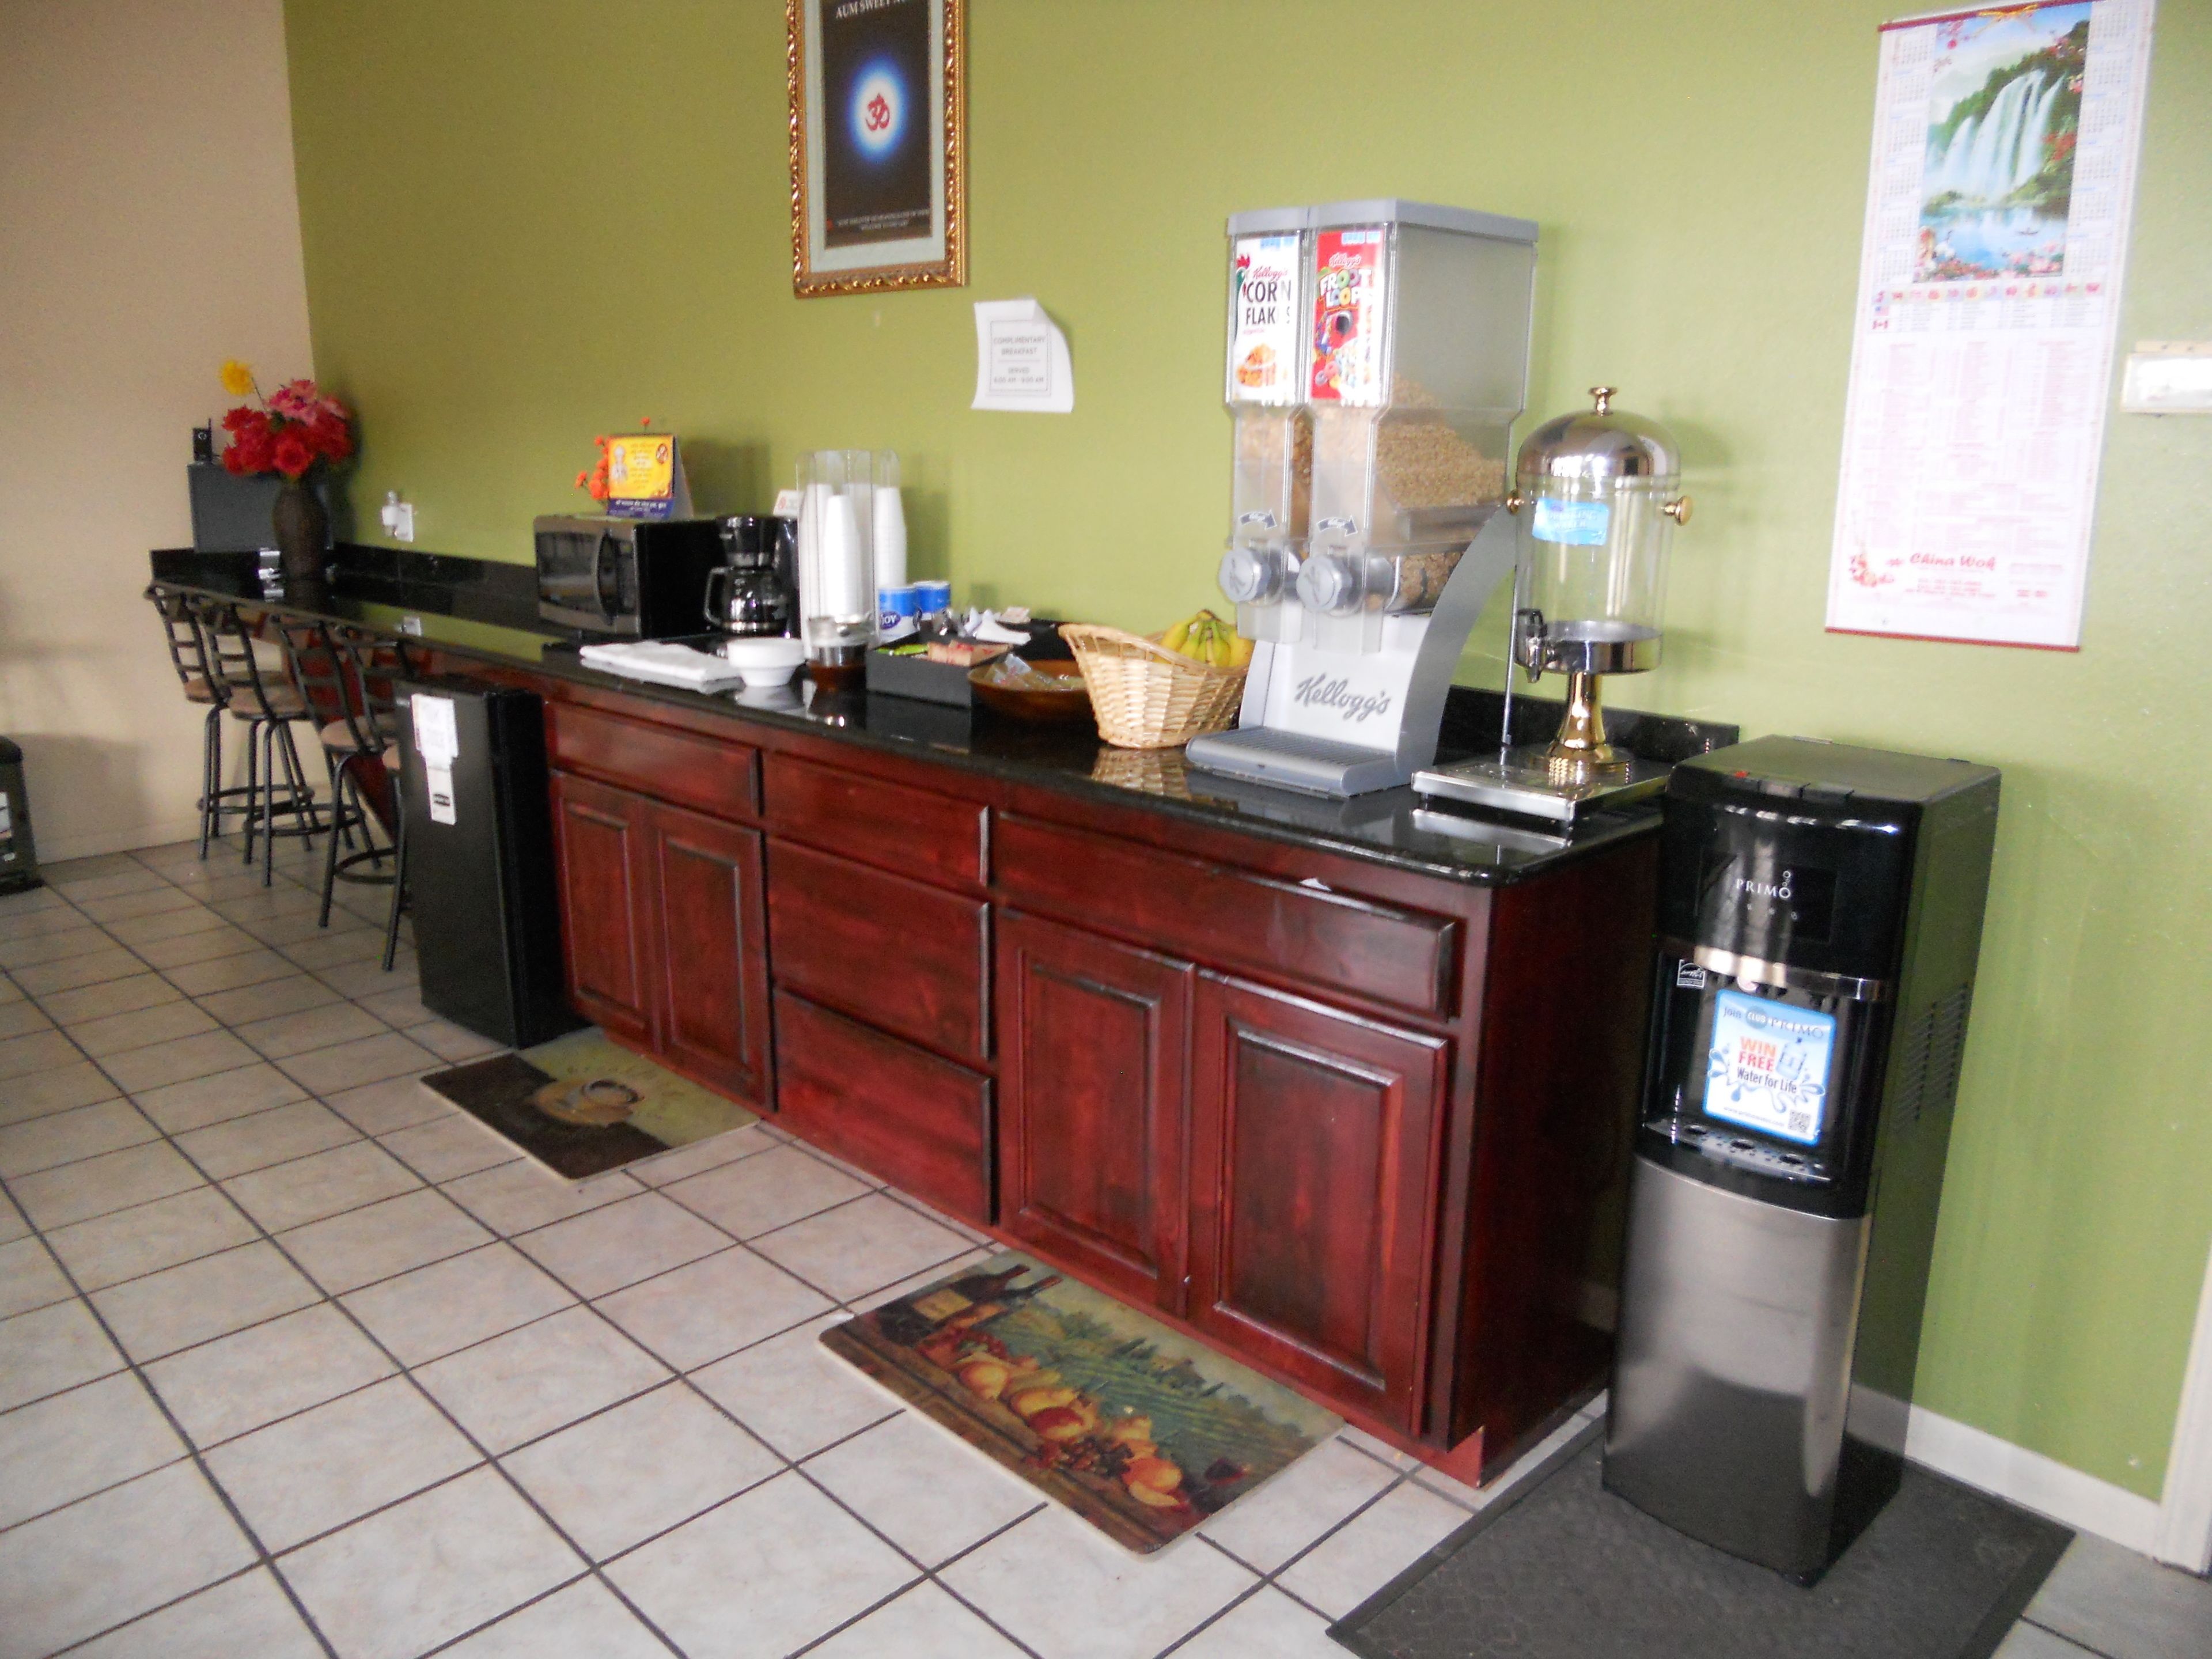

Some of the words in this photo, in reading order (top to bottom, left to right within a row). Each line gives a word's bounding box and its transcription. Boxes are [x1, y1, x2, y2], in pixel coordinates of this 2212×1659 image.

[836, 2, 859, 19] AUM
[1253, 265, 1288, 281] Kellogg's
[1320, 268, 1372, 297] FROOT
[1246, 279, 1291, 303] CORN
[1325, 287, 1373, 309] LOOP
[1246, 306, 1290, 326] FLAKS
[1001, 347, 1037, 355] BREAKFAST
[1910, 552, 1955, 566] China
[1960, 555, 1995, 571] Wok
[1296, 672, 1391, 721] Kellogg's
[1736, 878, 1791, 899] PRIMO
[1724, 1007, 1742, 1019] Join
[1747, 1012, 1766, 1023] CLUB
[1771, 1017, 1824, 1039] PRIMO
[1740, 1036, 1777, 1058] WIN
[1738, 1051, 1775, 1072] FREE
[1737, 1066, 1762, 1085] Water
[1765, 1074, 1778, 1089] for
[1781, 1079, 1797, 1094] Life
